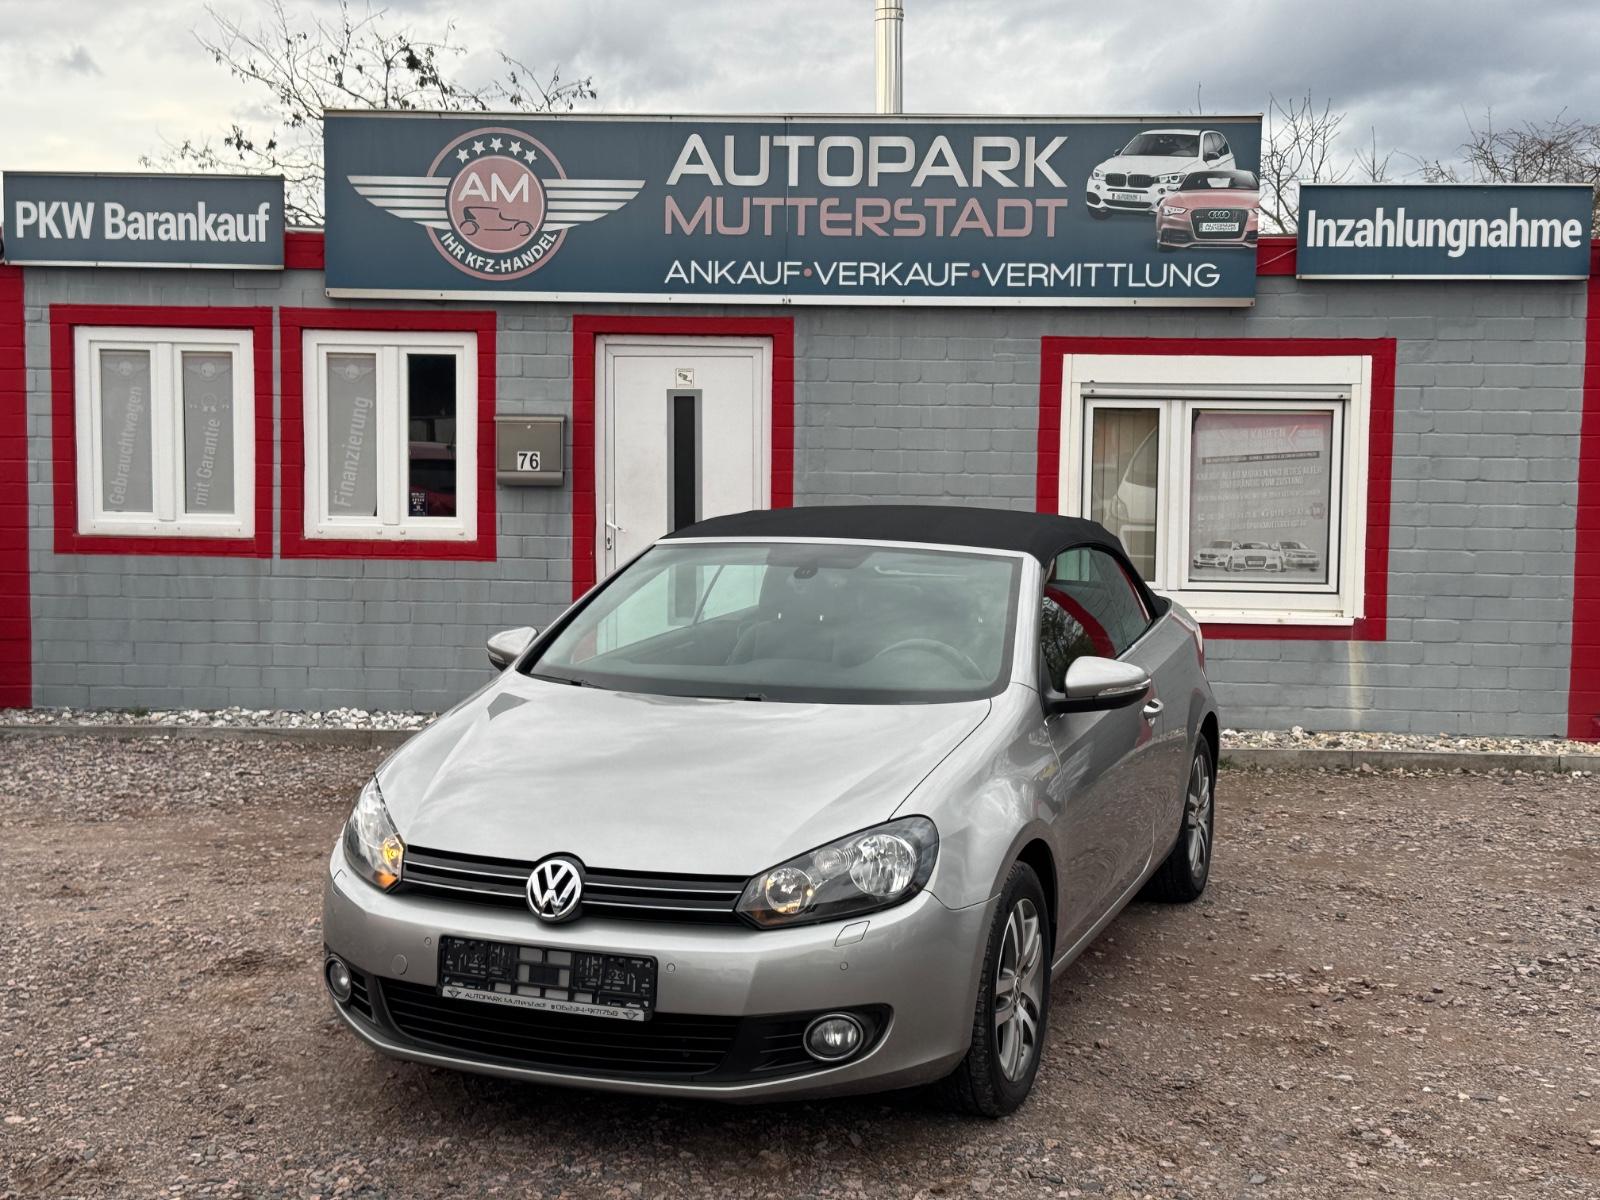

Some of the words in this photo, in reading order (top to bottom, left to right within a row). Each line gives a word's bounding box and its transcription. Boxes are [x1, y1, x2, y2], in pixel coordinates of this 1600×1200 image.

[666, 133, 1068, 189] AUTOPARK
[457, 171, 529, 203] AM
[15, 200, 95, 239] PKW
[104, 200, 271, 243] Barankauf
[664, 195, 1069, 238] MUTTERSTADT
[1306, 207, 1583, 258] Inzahlungnahme
[440, 232, 465, 260] IHR
[465, 233, 557, 272] KFZ-HANDEL
[664, 260, 803, 284] ANKAUF
[813, 261, 971, 287] VERKAUF
[981, 263, 1221, 288] VERMITTLUNG
[109, 386, 143, 506] Gebrauchtwagen
[196, 418, 221, 480] Garantie
[334, 396, 373, 508] Finanzierung
[518, 452, 540, 470] 76
[193, 482, 210, 506] mit
[527, 859, 582, 919] VW
